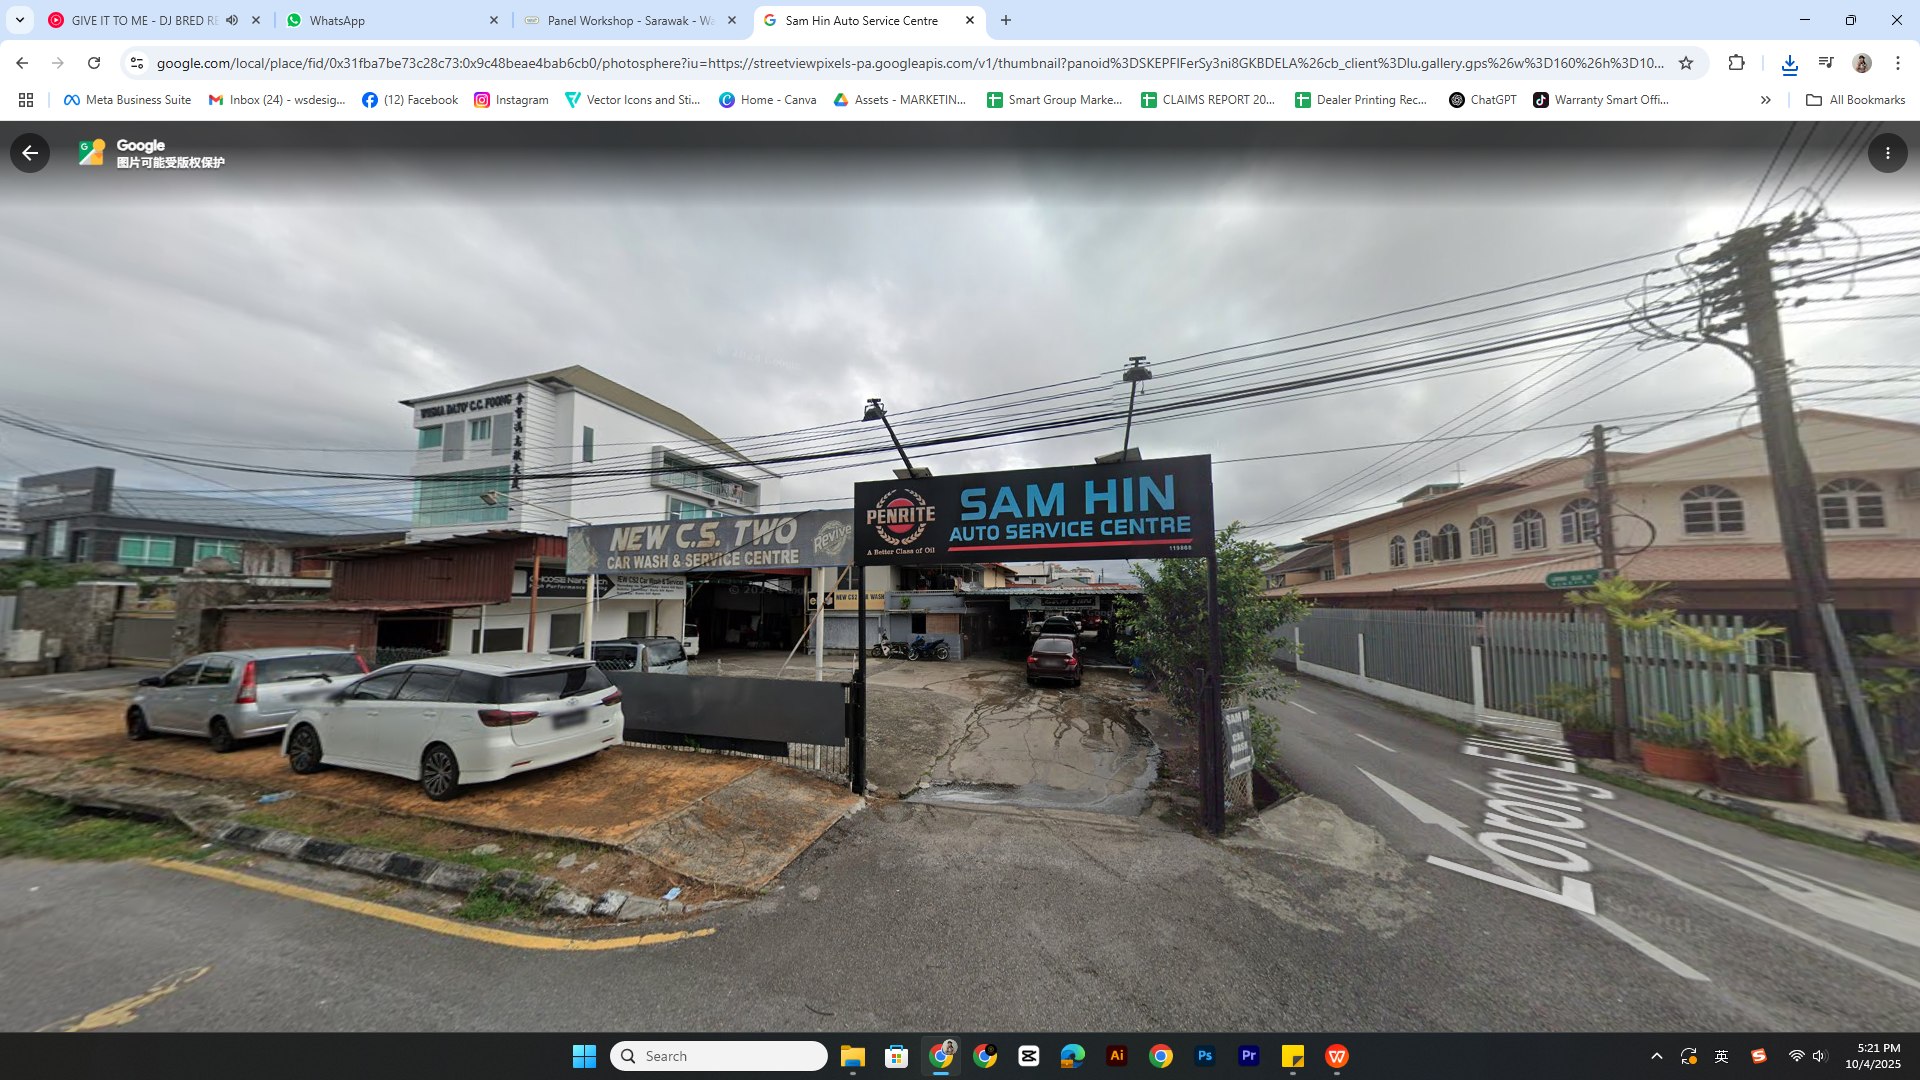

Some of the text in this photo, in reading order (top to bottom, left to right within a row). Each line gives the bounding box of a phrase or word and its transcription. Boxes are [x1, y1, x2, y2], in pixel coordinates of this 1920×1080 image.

[71, 15, 98, 26] GIVE
[100, 15, 111, 26] IT
[112, 15, 129, 26] TO
[131, 15, 149, 26] ME
[159, 15, 172, 26] DJ
[175, 15, 205, 26] BRED
[309, 15, 366, 29] WhatsApp
[548, 15, 577, 26] Panel
[579, 15, 634, 29] Workshop
[644, 15, 690, 26] Sarawak
[785, 15, 939, 26] Sam Hin Auto Service Centre
[86, 94, 192, 105] Meta Business Suite
[230, 94, 261, 105] Inbox
[262, 94, 284, 107] (24)
[383, 94, 459, 107] (12) Facebook
[496, 94, 549, 108] Instagram
[586, 94, 622, 105] Vector
[624, 94, 653, 105] Icons
[654, 94, 676, 105] and
[741, 94, 774, 105] Home
[783, 94, 817, 105] Canva
[854, 94, 890, 105] Assets
[1008, 94, 1041, 105] Smart
[1042, 94, 1078, 108] Group
[1162, 94, 1206, 105] CLAIMS
[1207, 94, 1251, 105] REPORT
[1317, 94, 1353, 105] Dealer
[1354, 94, 1397, 108] Printing
[1470, 94, 1518, 105] ChatGPT
[1554, 94, 1605, 108] Warranty
[1605, 94, 1639, 105] Smart
[1829, 94, 1907, 105] All Bookmarks
[961, 474, 1175, 521] SAM HIN
[866, 506, 936, 525] PENRITE
[609, 517, 798, 552] NEW C.S. TWO
[949, 515, 1191, 542] AUTO SERVICE CENTRE
[814, 525, 852, 553] Revive
[924, 546, 936, 554] Oil
[607, 549, 799, 570] CAR WASH & SERVICE CENTRE
[1232, 731, 1244, 743] CAR
[1857, 1043, 1902, 1053] 5:21 PM
[646, 1050, 687, 1062] Search
[1714, 1049, 1730, 1064] 英
[1844, 1058, 1902, 1071] 10/4/2025
